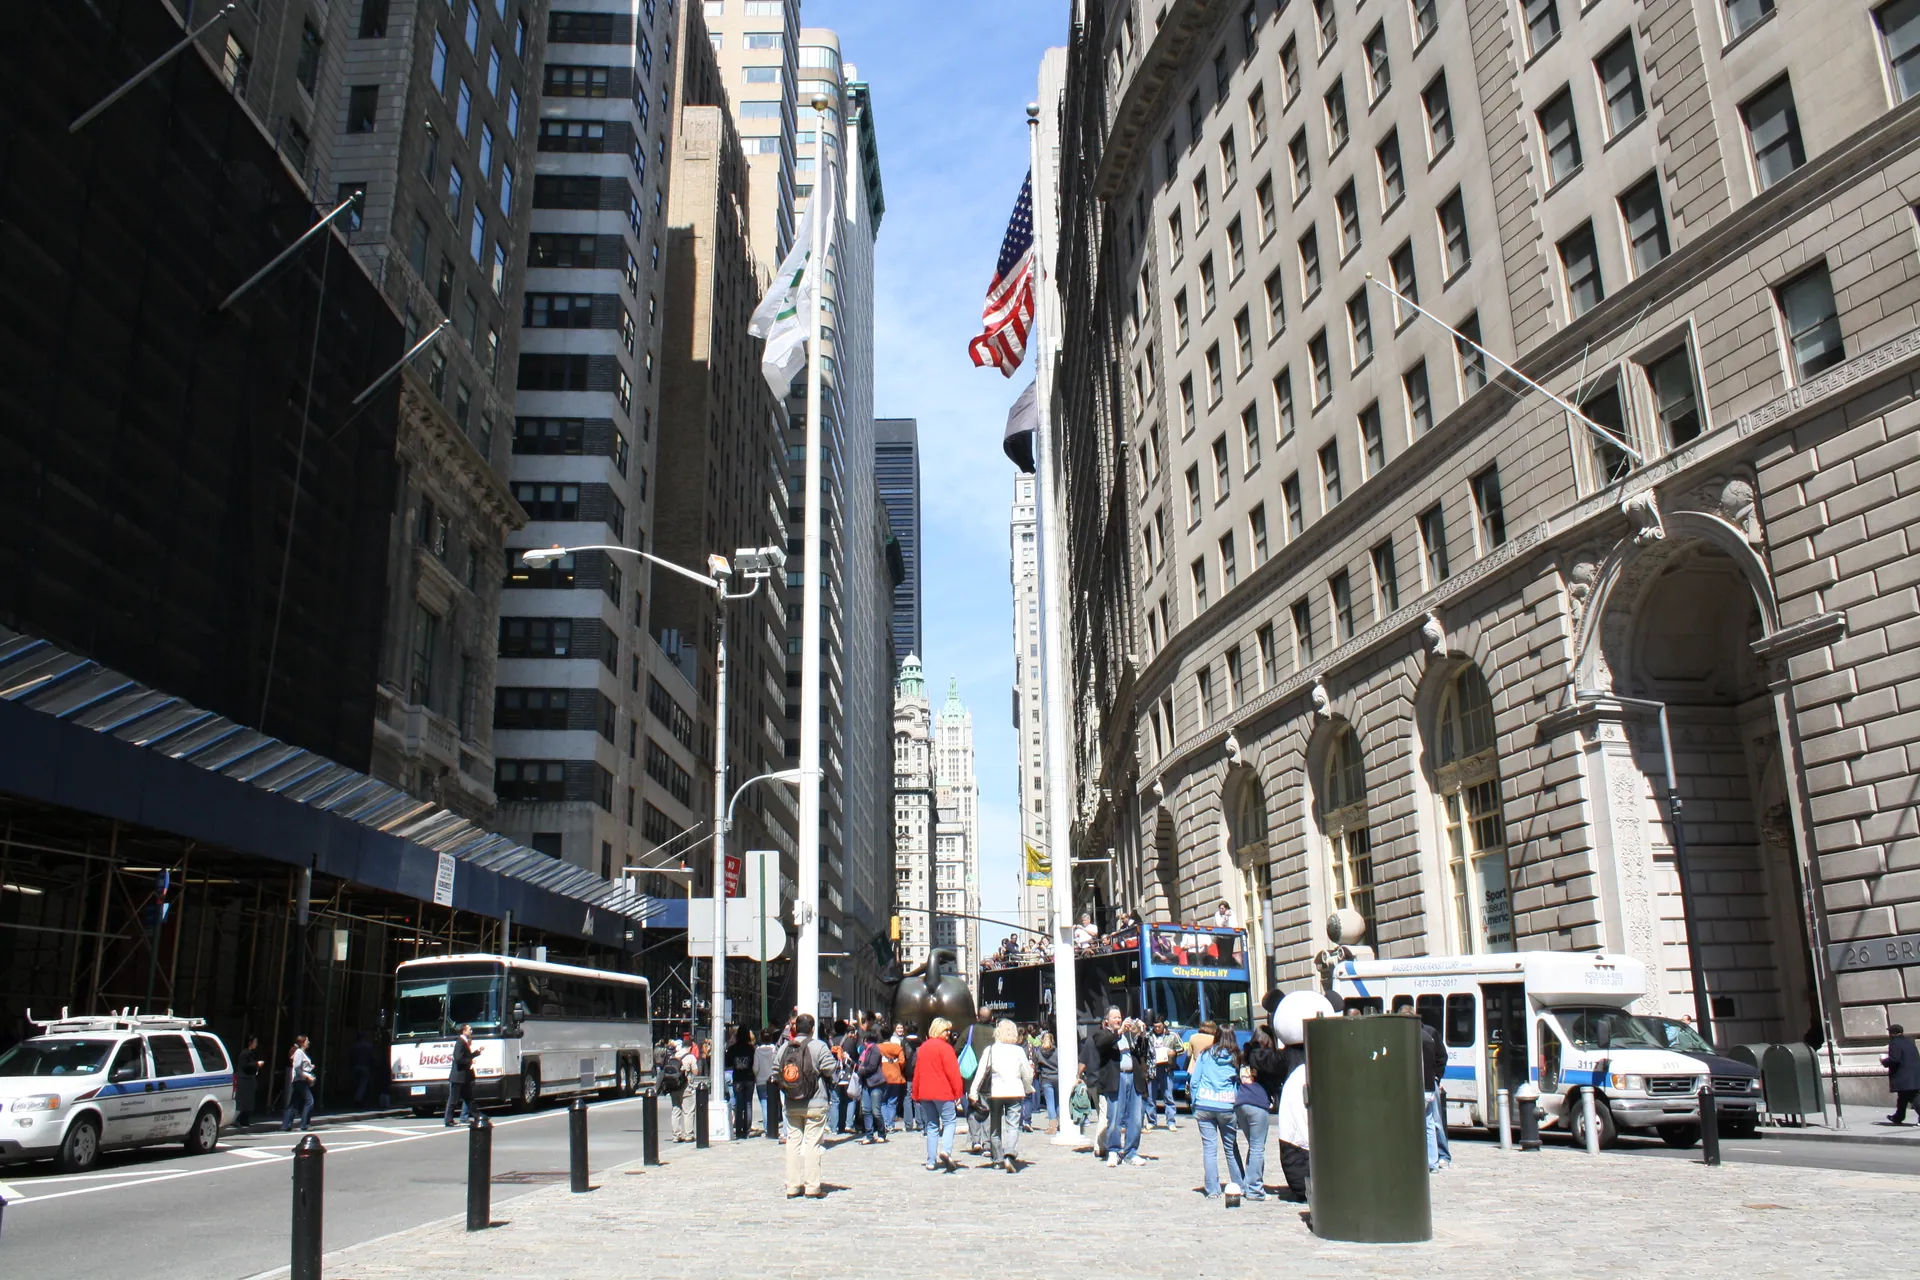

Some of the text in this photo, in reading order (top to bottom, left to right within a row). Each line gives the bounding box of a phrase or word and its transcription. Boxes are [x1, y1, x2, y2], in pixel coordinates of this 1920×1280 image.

[728, 861, 735, 870] NO
[1481, 901, 1508, 914] museum
[1847, 946, 1871, 965] 26
[1172, 966, 1229, 978] CitySights NY
[1413, 978, 1458, 988] 1-877-337-2017
[419, 1051, 453, 1066] buses
